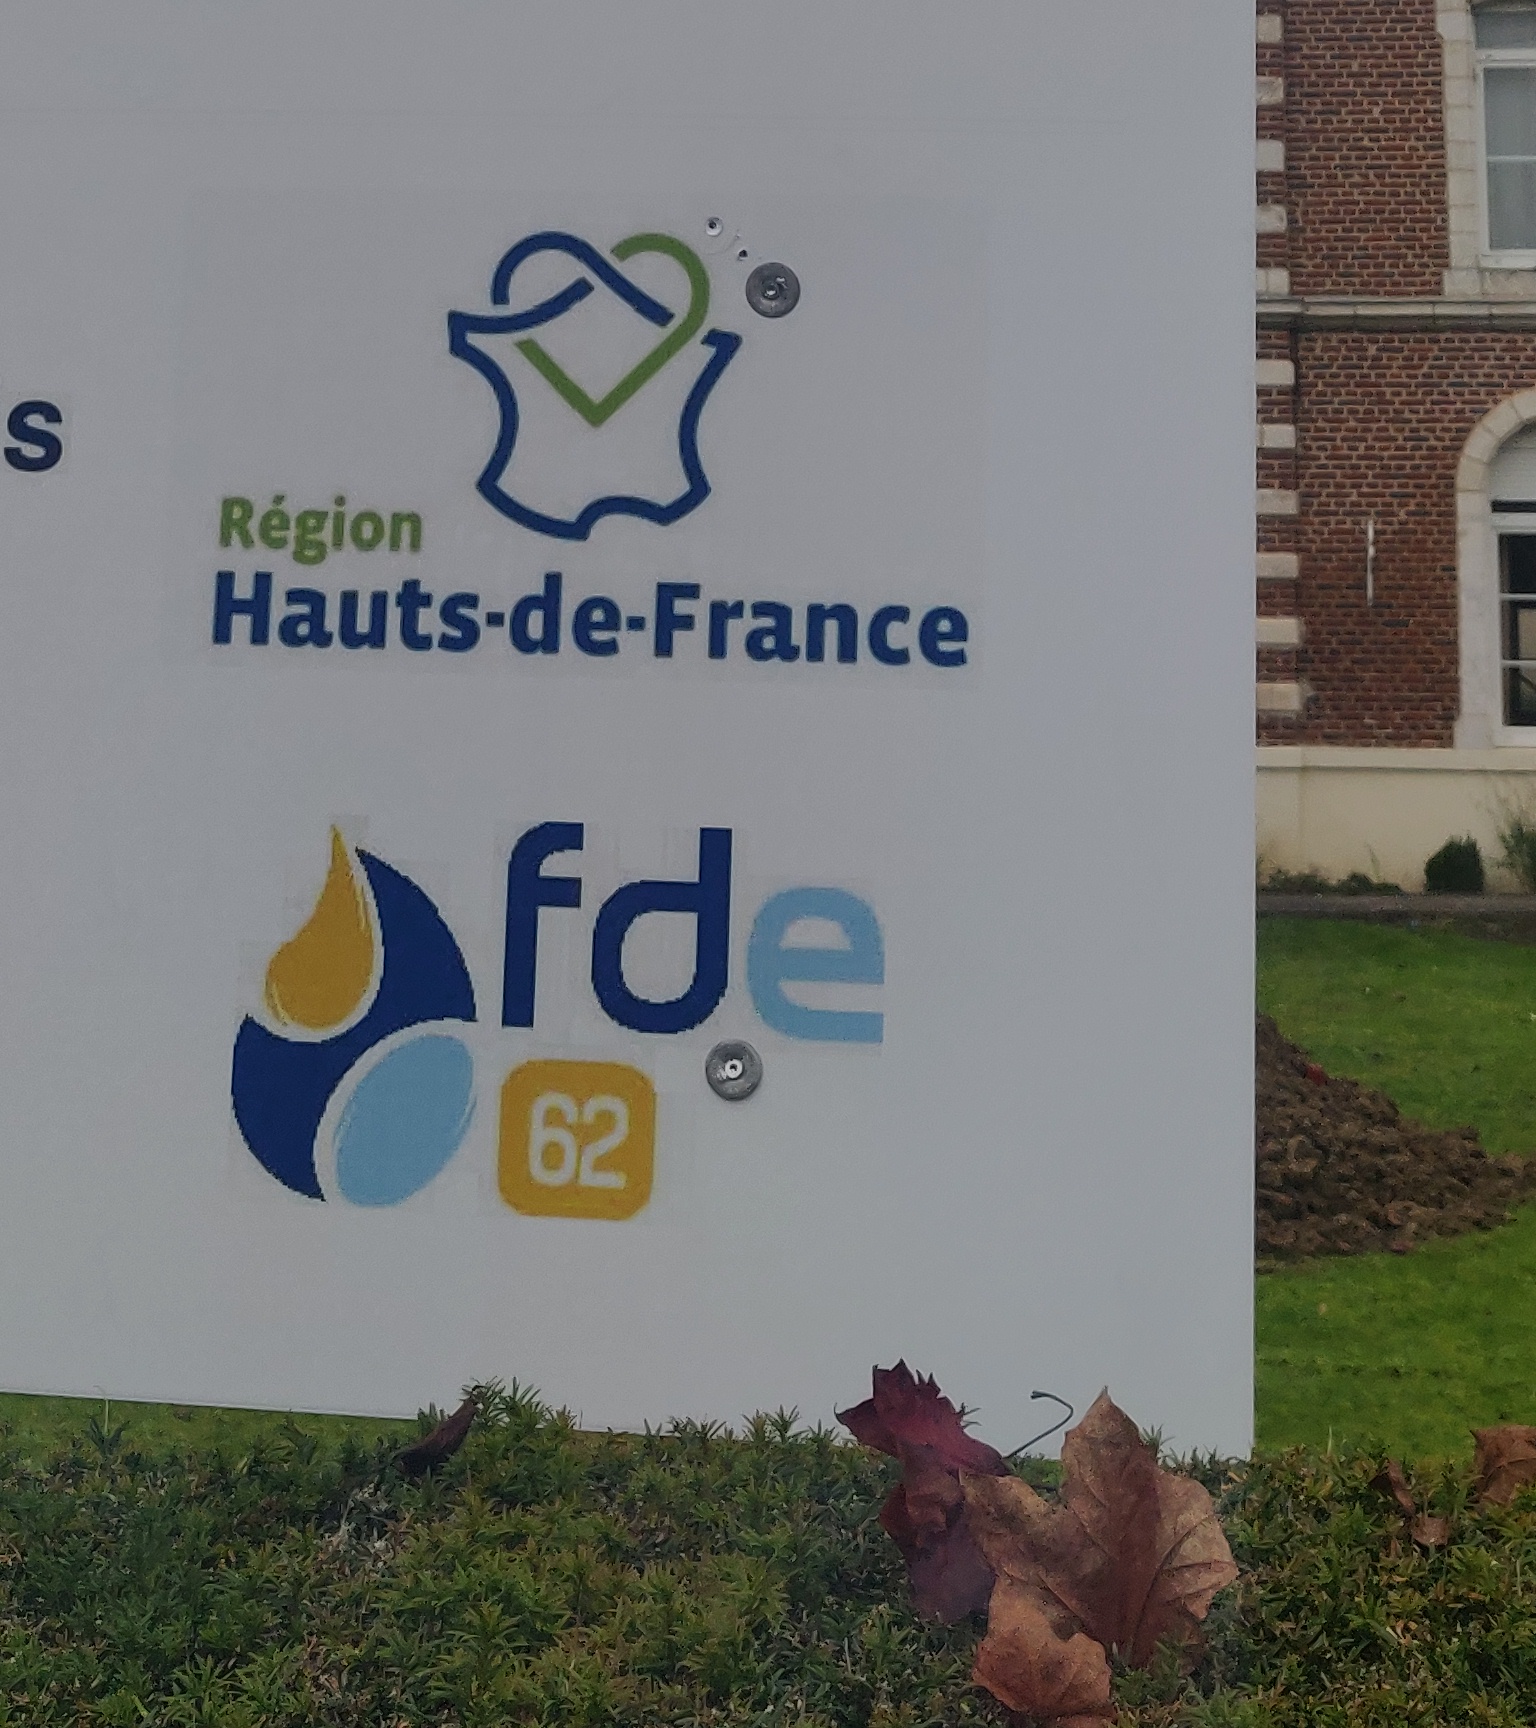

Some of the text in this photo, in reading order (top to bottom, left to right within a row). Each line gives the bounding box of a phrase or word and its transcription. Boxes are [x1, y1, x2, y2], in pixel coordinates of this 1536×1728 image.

[217, 492, 424, 566] Région
[211, 570, 969, 668] Hauts-de-France
[527, 1090, 630, 1189] 62
